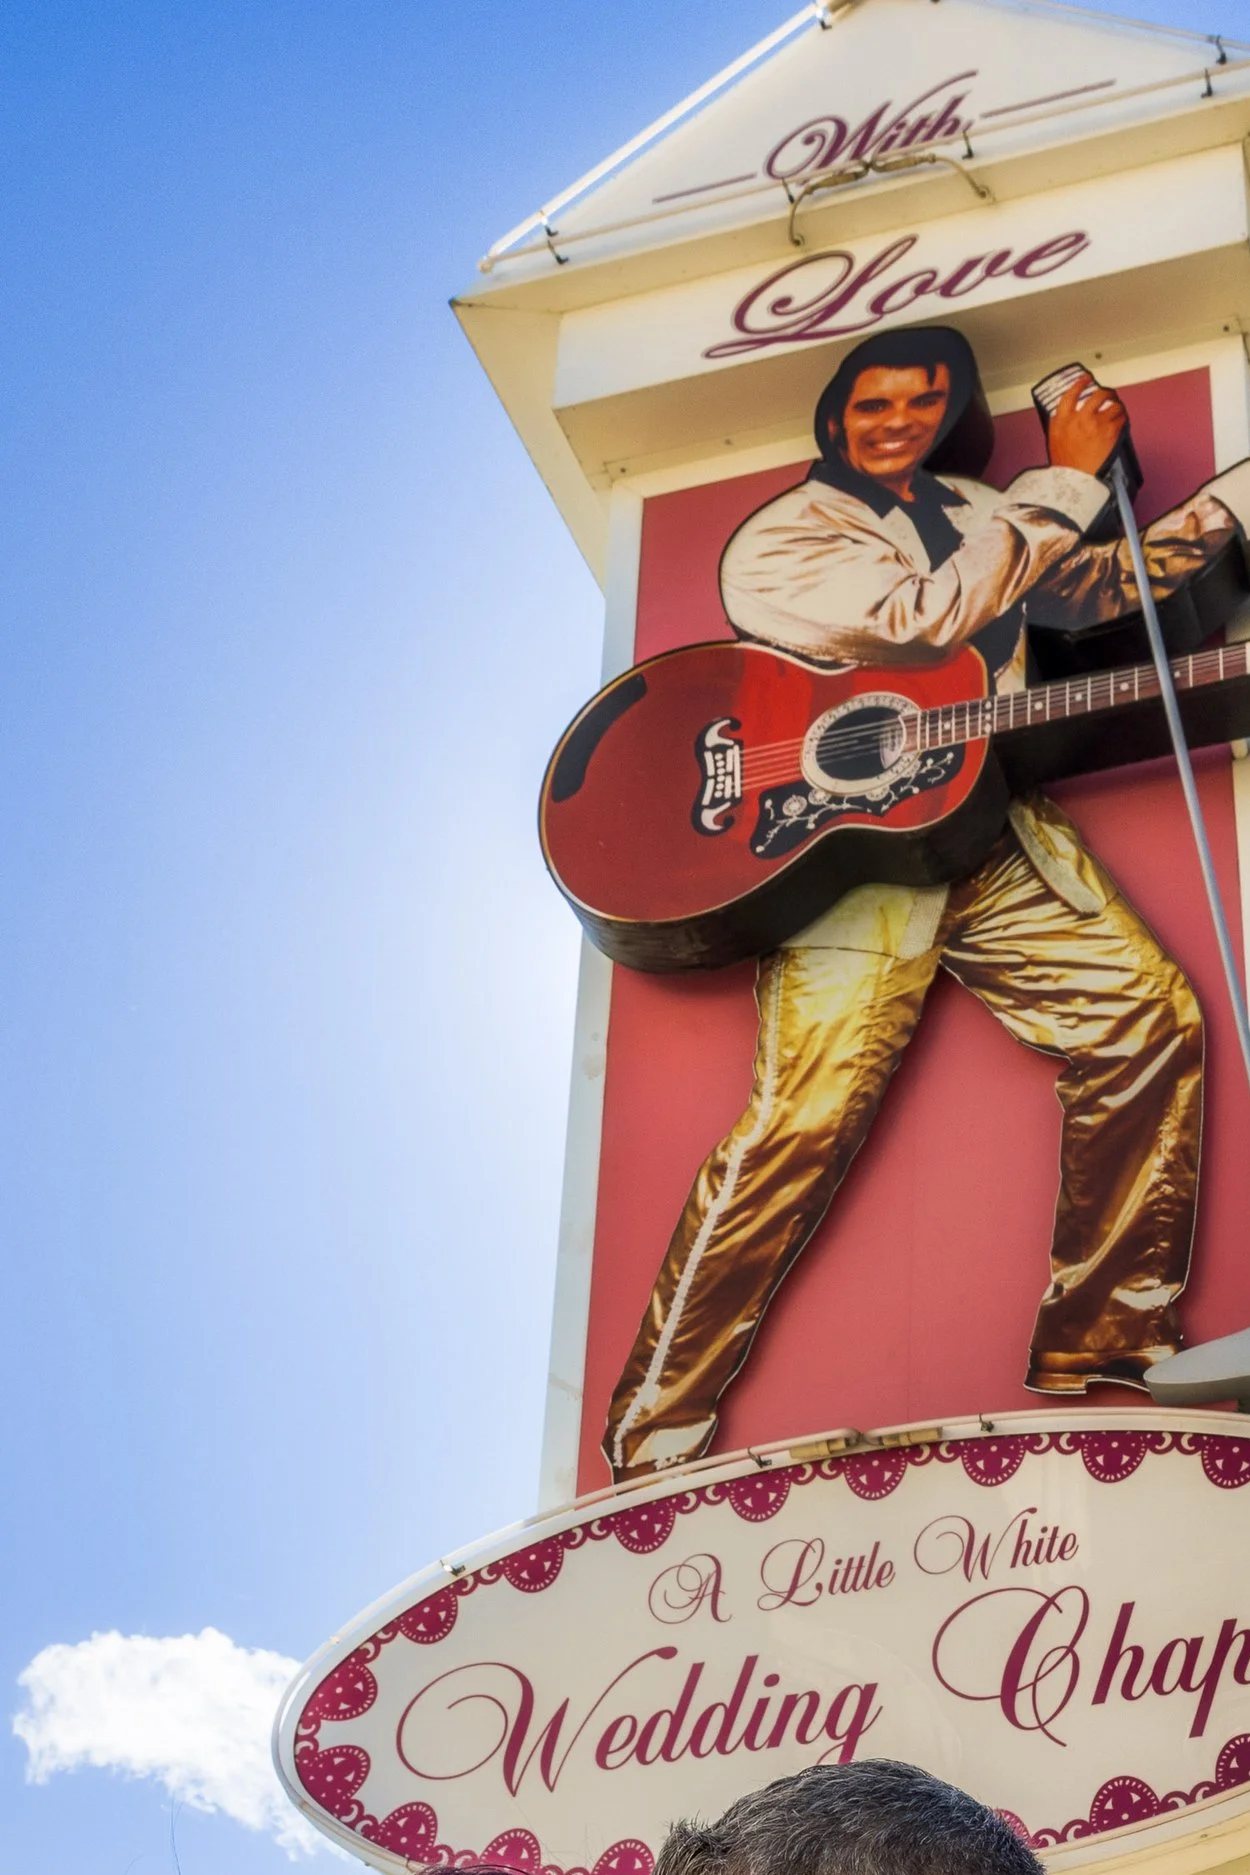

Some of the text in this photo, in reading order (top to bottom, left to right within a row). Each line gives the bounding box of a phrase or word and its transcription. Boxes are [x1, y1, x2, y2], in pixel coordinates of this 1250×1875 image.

[763, 70, 976, 181] With
[703, 230, 1093, 360] Love
[649, 1506, 1080, 1625] A Little White
[396, 1646, 882, 1796] Wedding
